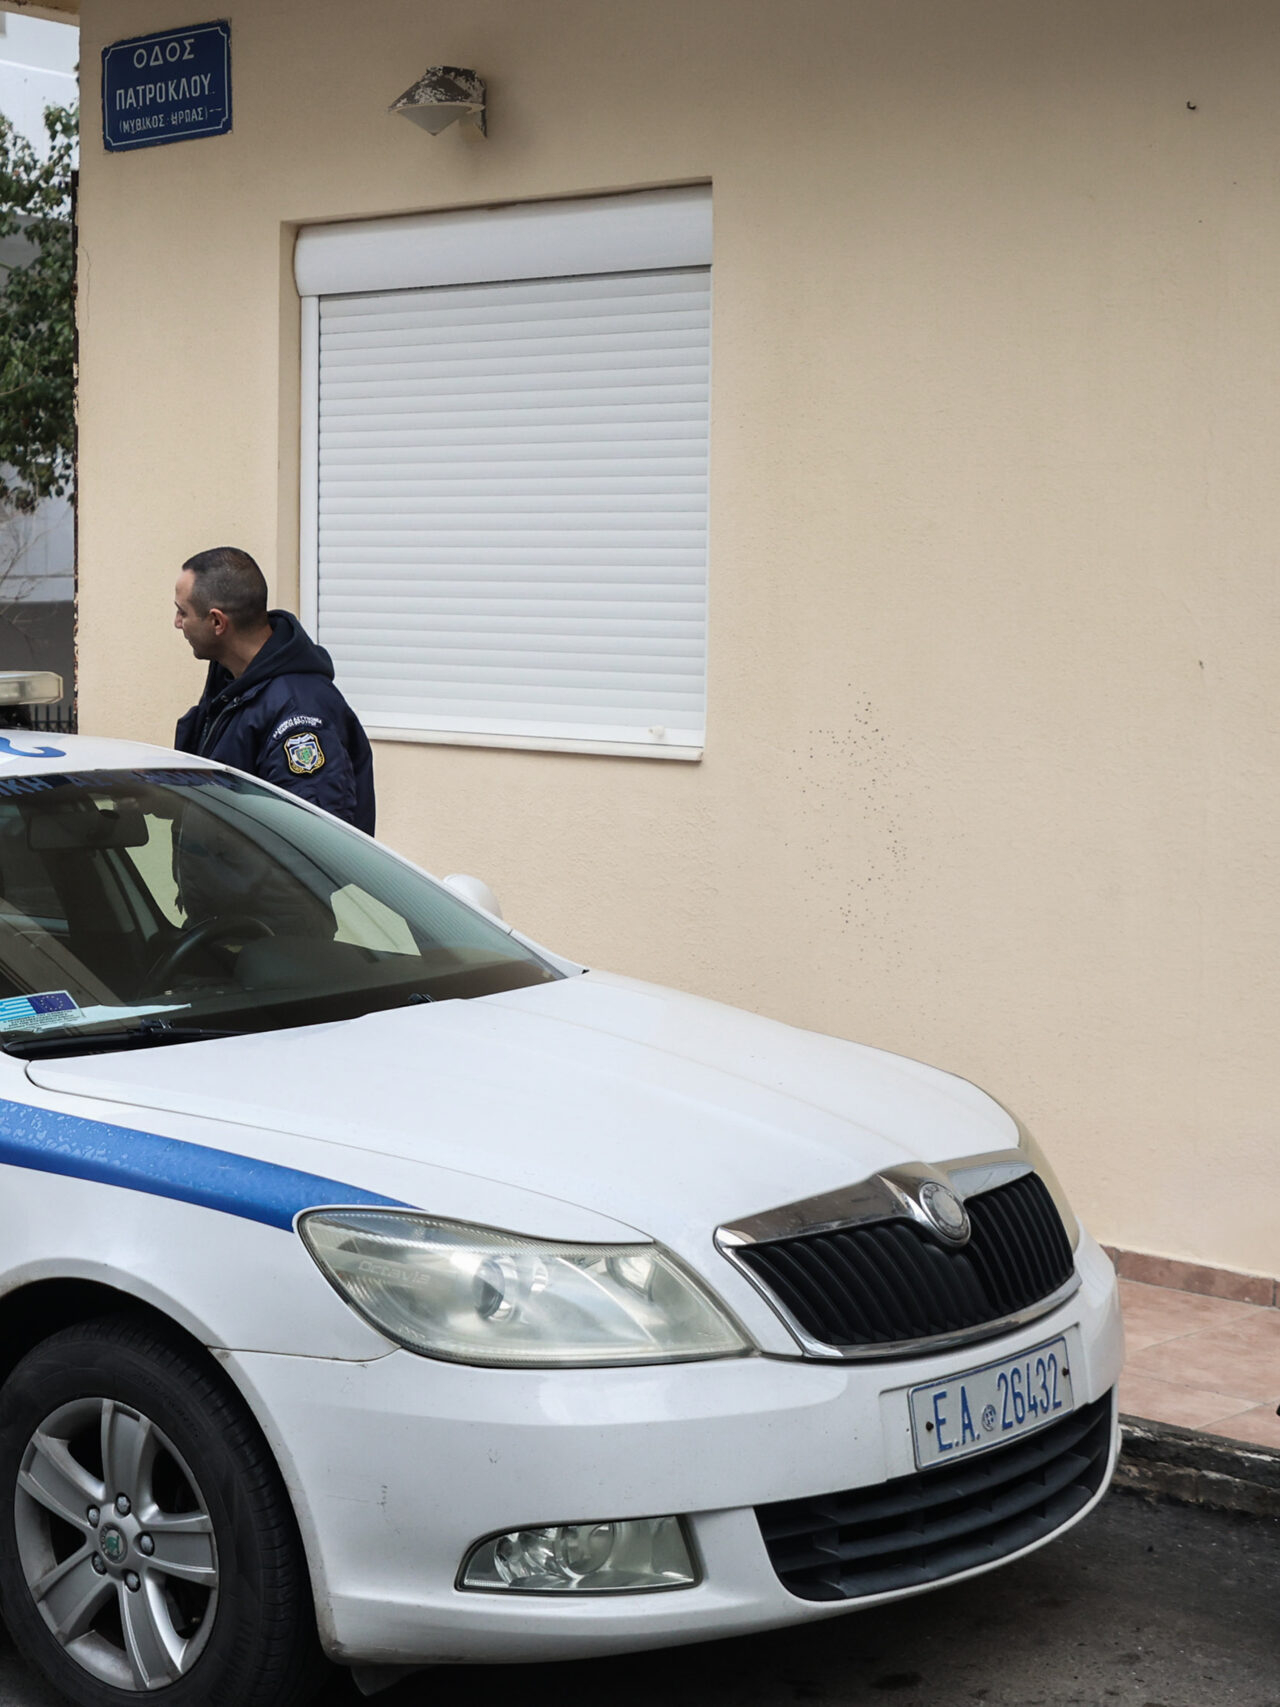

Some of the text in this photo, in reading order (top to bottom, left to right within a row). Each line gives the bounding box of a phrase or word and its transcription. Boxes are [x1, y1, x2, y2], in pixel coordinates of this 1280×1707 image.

[133, 38, 195, 68] ΟΔΟΣ
[116, 73, 211, 111] ΠΑΤΡΟΚΛΟΥ
[996, 1352, 1062, 1431] 26432
